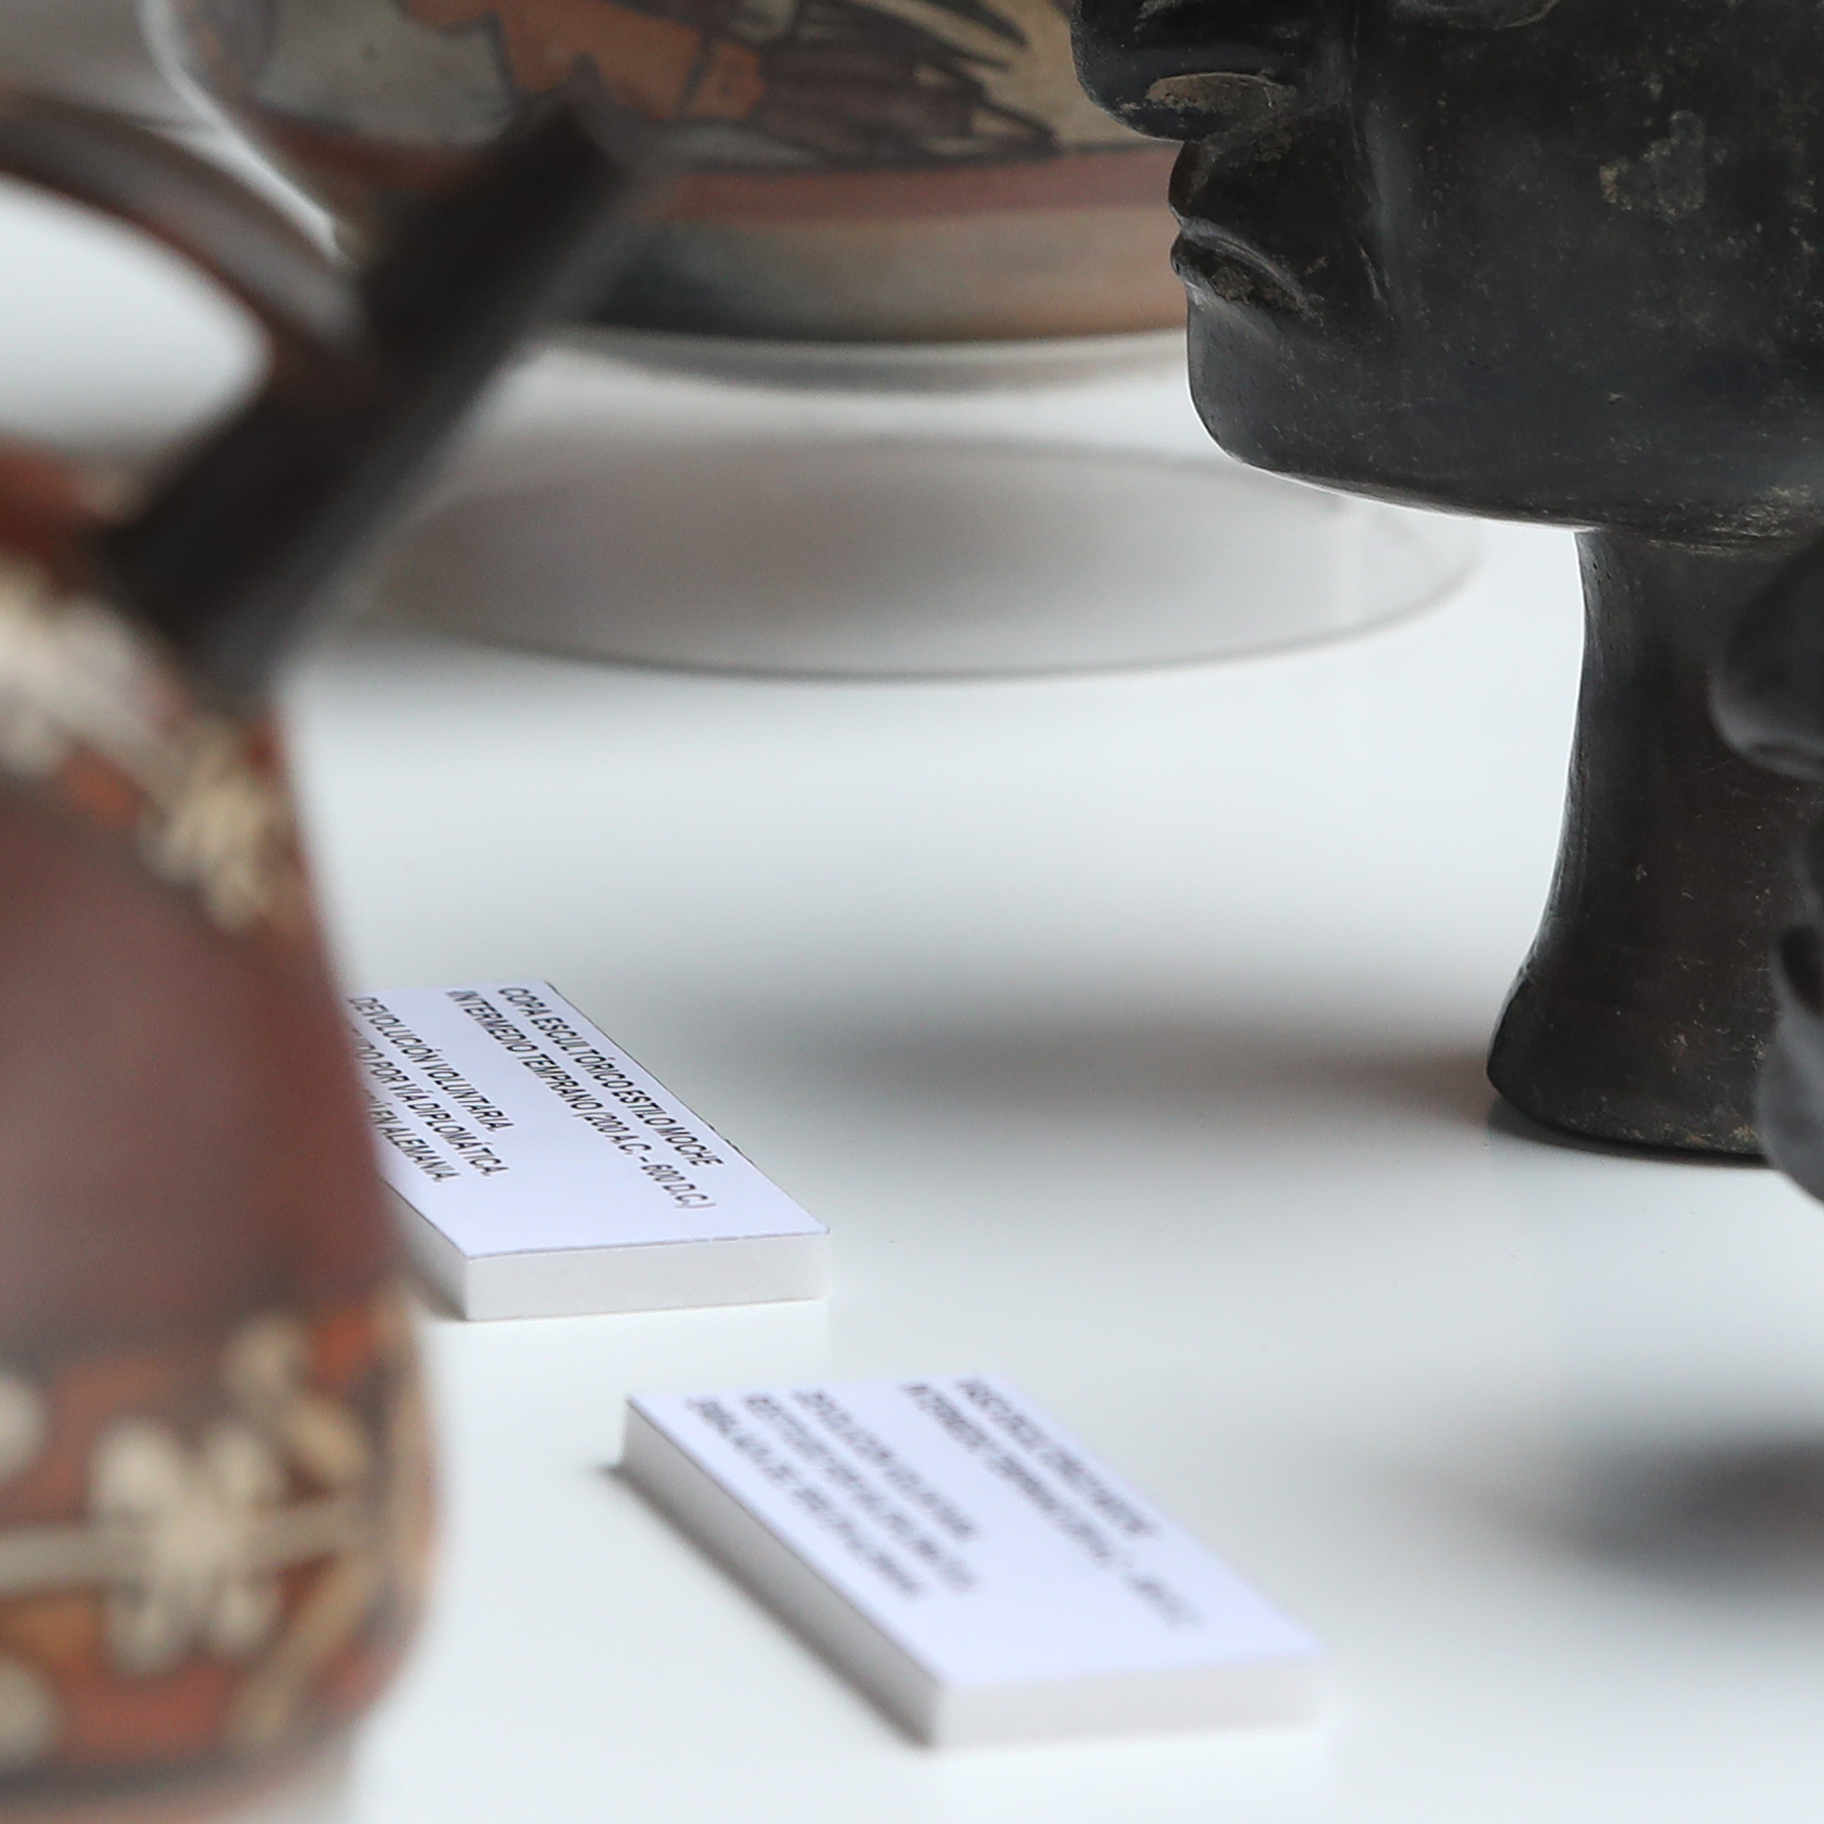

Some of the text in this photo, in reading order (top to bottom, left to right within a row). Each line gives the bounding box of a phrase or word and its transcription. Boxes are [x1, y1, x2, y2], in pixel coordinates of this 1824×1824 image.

[348, 997, 444, 1063] DEVOLUCIÓN
[446, 990, 539, 1053] INTERMEDIO
[517, 1053, 604, 1110] TEMPRANO
[572, 1111, 631, 1133] (200
[531, 1017, 635, 1088] ESCULTÓRICO
[653, 1127, 724, 1166] MOCHE
